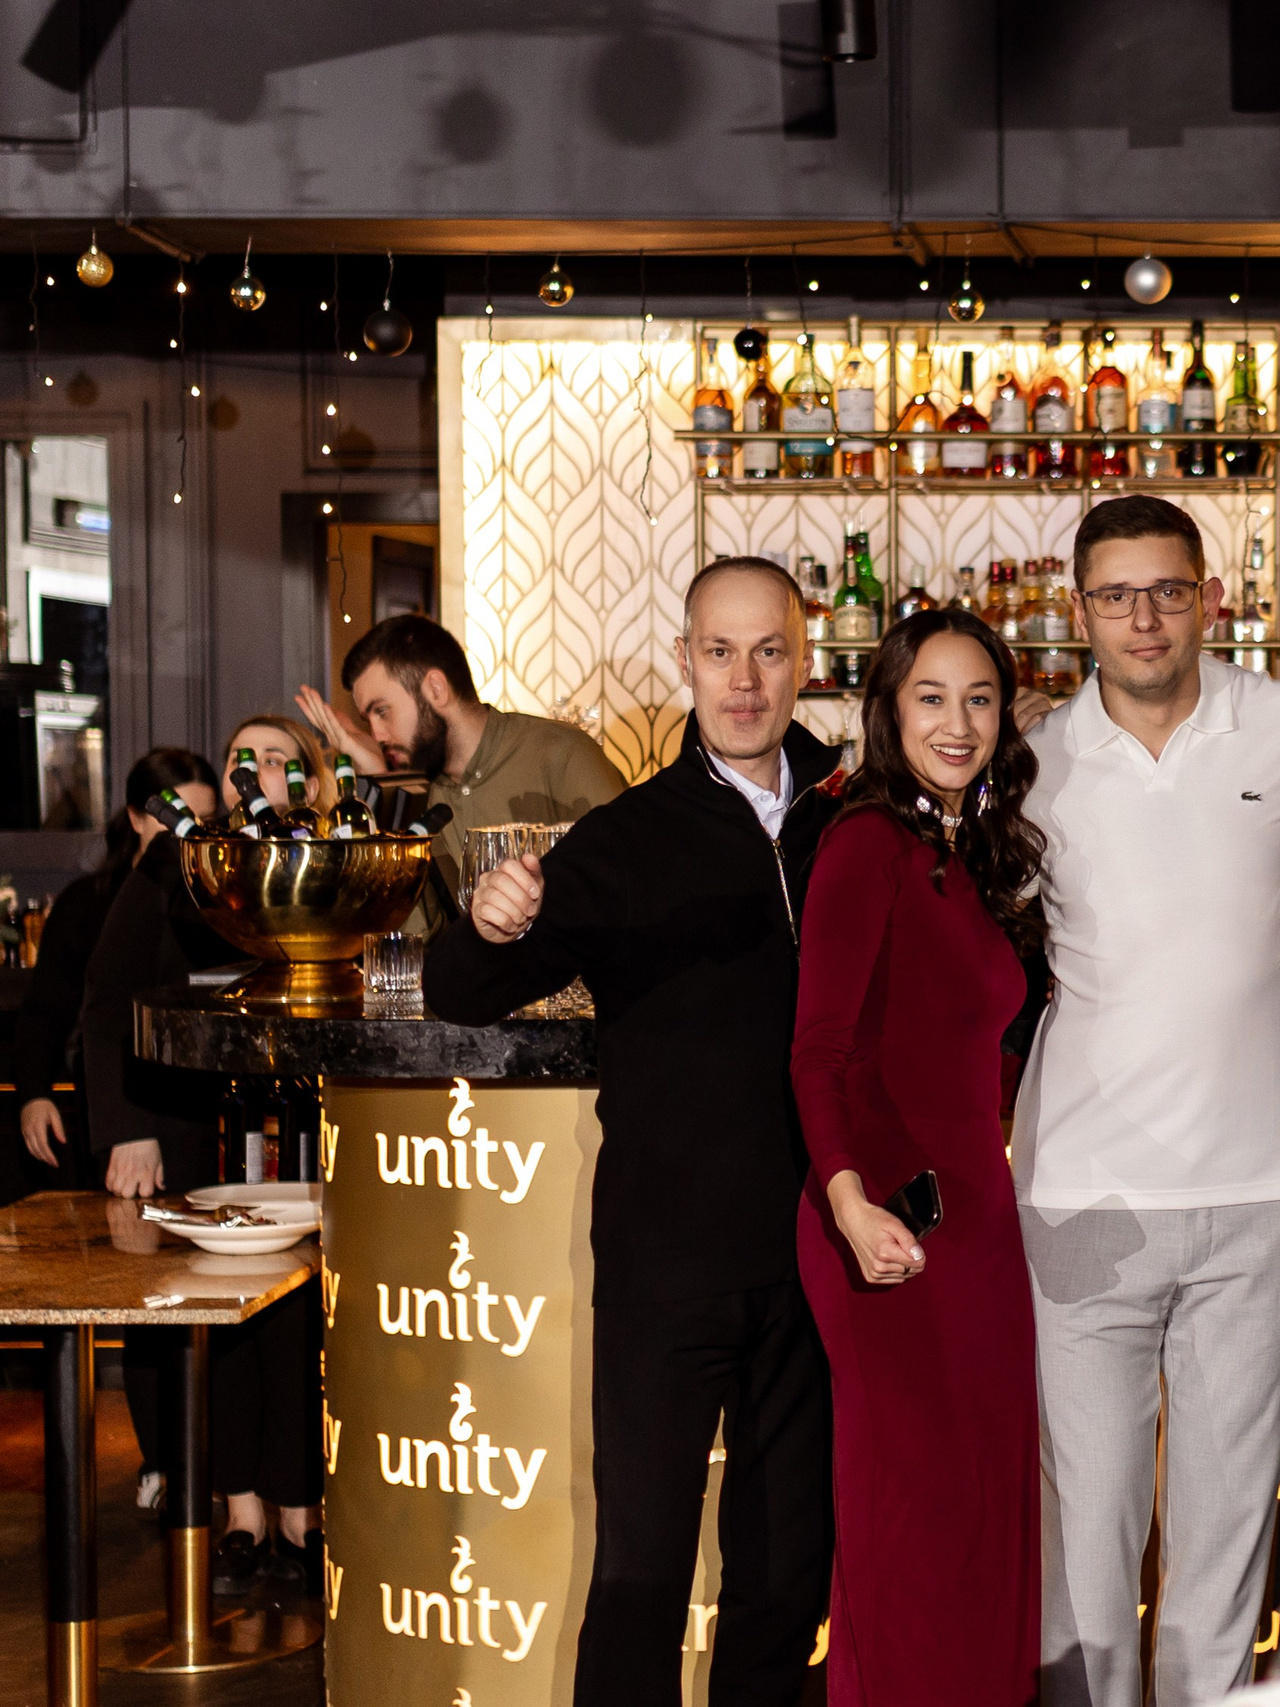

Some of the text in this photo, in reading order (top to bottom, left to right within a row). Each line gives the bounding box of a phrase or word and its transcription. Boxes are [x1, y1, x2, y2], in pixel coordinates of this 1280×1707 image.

[375, 1128, 546, 1204] unity
[376, 1281, 547, 1357] unity
[377, 1433, 547, 1510] unity
[380, 1583, 548, 1662] unity
